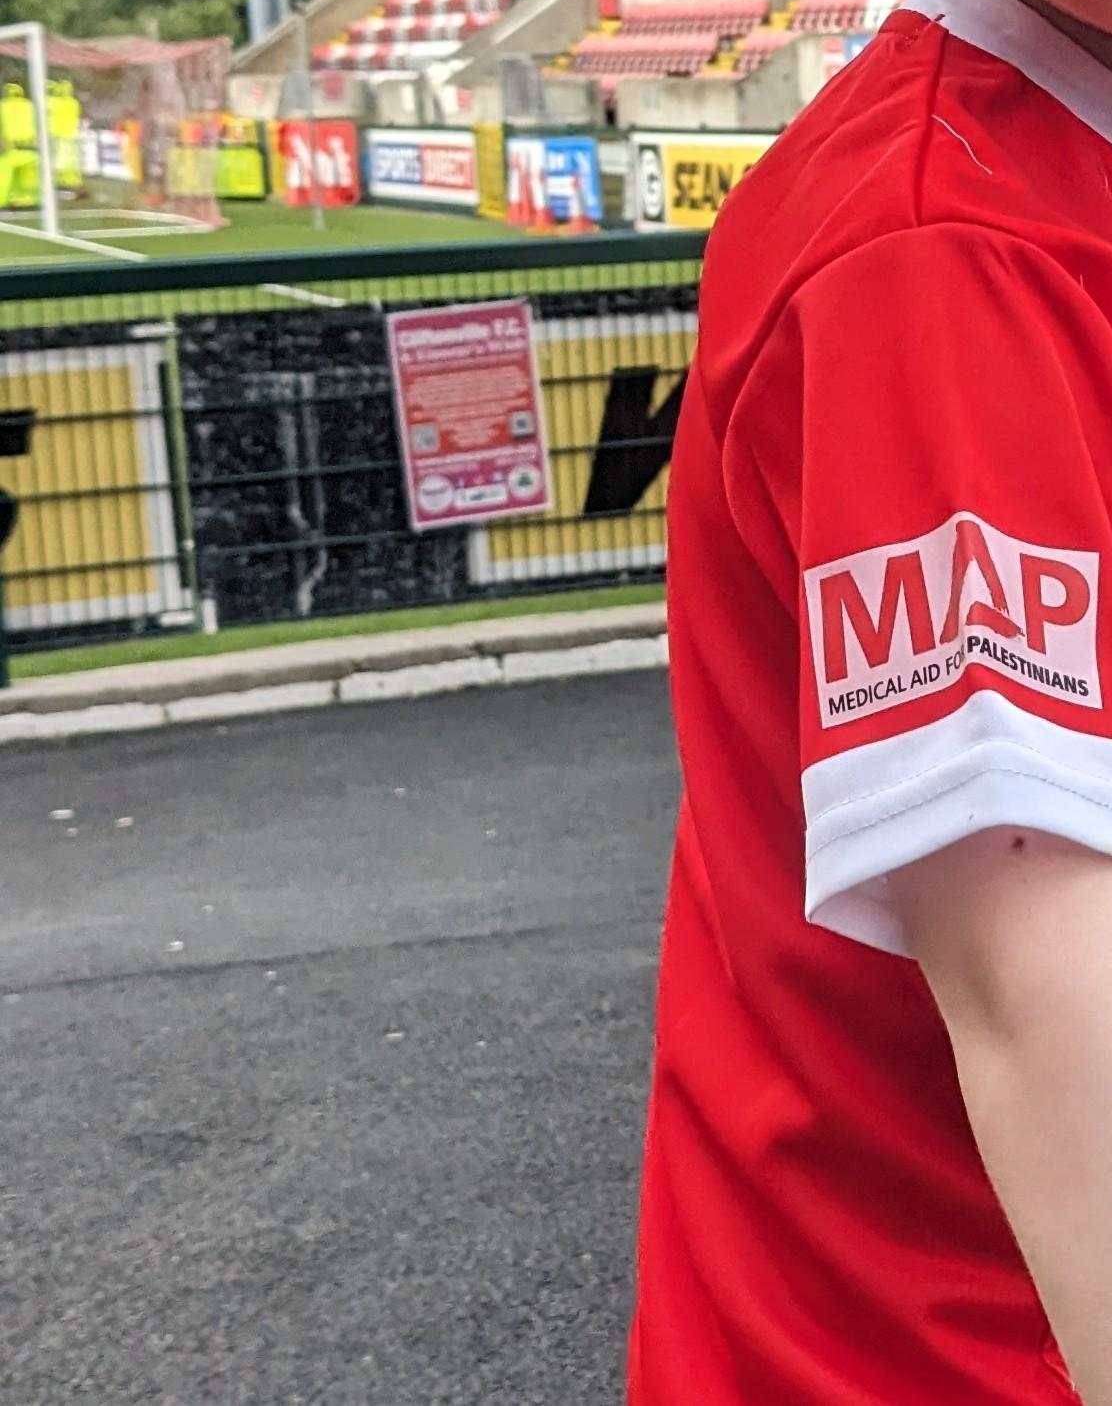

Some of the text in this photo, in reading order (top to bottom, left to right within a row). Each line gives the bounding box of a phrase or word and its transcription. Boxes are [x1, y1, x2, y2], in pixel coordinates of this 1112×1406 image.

[819, 520, 1091, 684] MAP
[828, 676, 907, 716] MEDICAL
[911, 663, 941, 690] AID
[967, 635, 1090, 697] PALESTINIANS
